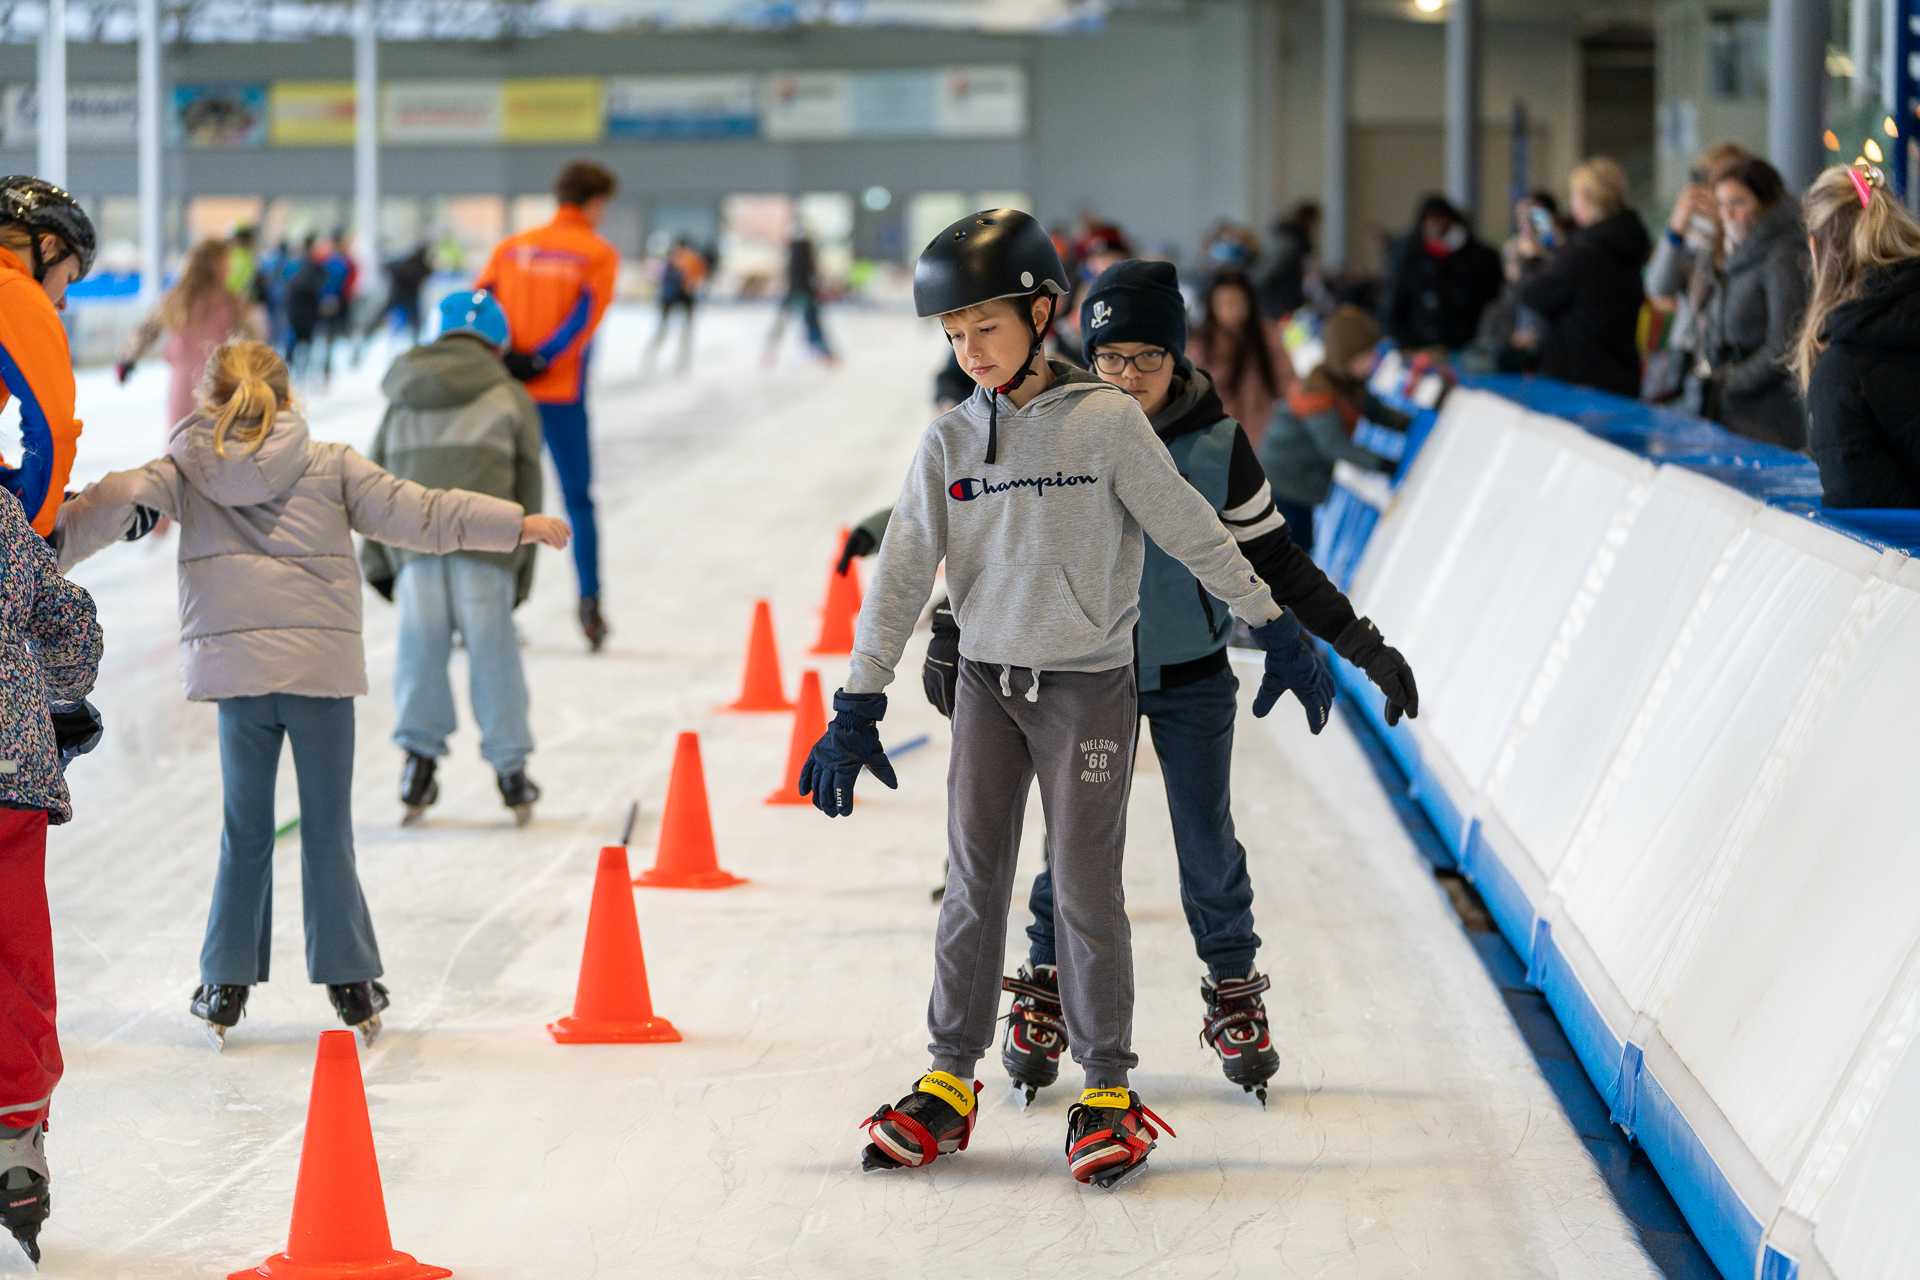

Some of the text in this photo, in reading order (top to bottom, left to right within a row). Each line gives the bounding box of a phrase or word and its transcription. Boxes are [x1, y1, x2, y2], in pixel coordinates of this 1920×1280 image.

[949, 472, 1098, 501] Champion
[1080, 739, 1119, 753] NIELSSON
[1085, 753, 1108, 769] '68
[1081, 770, 1111, 783] QUALITY
